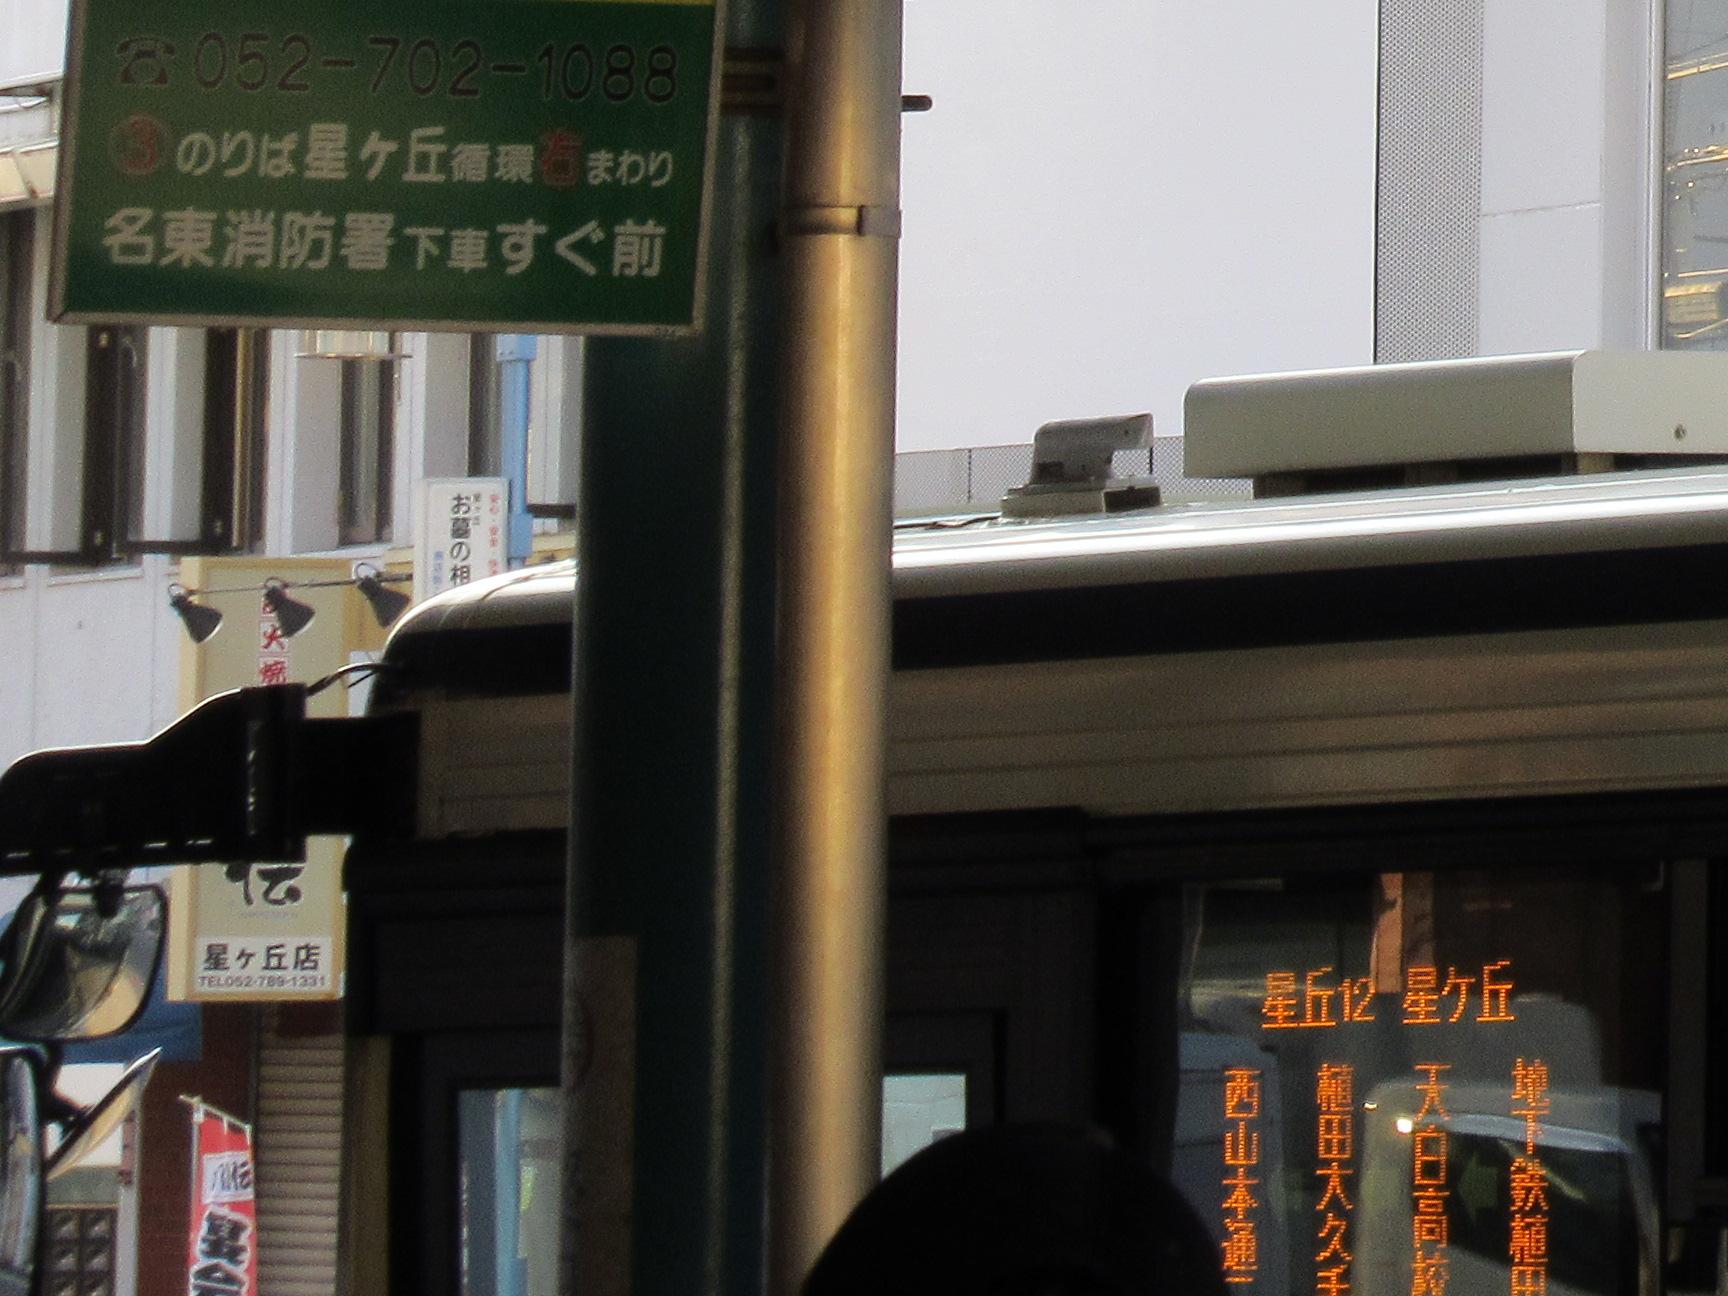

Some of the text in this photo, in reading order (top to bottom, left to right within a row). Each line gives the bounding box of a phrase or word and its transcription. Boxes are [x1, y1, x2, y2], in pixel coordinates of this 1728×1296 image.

[191, 32, 678, 104] 052-702-1088
[103, 207, 666, 279] 名東消防署下車すぐ前
